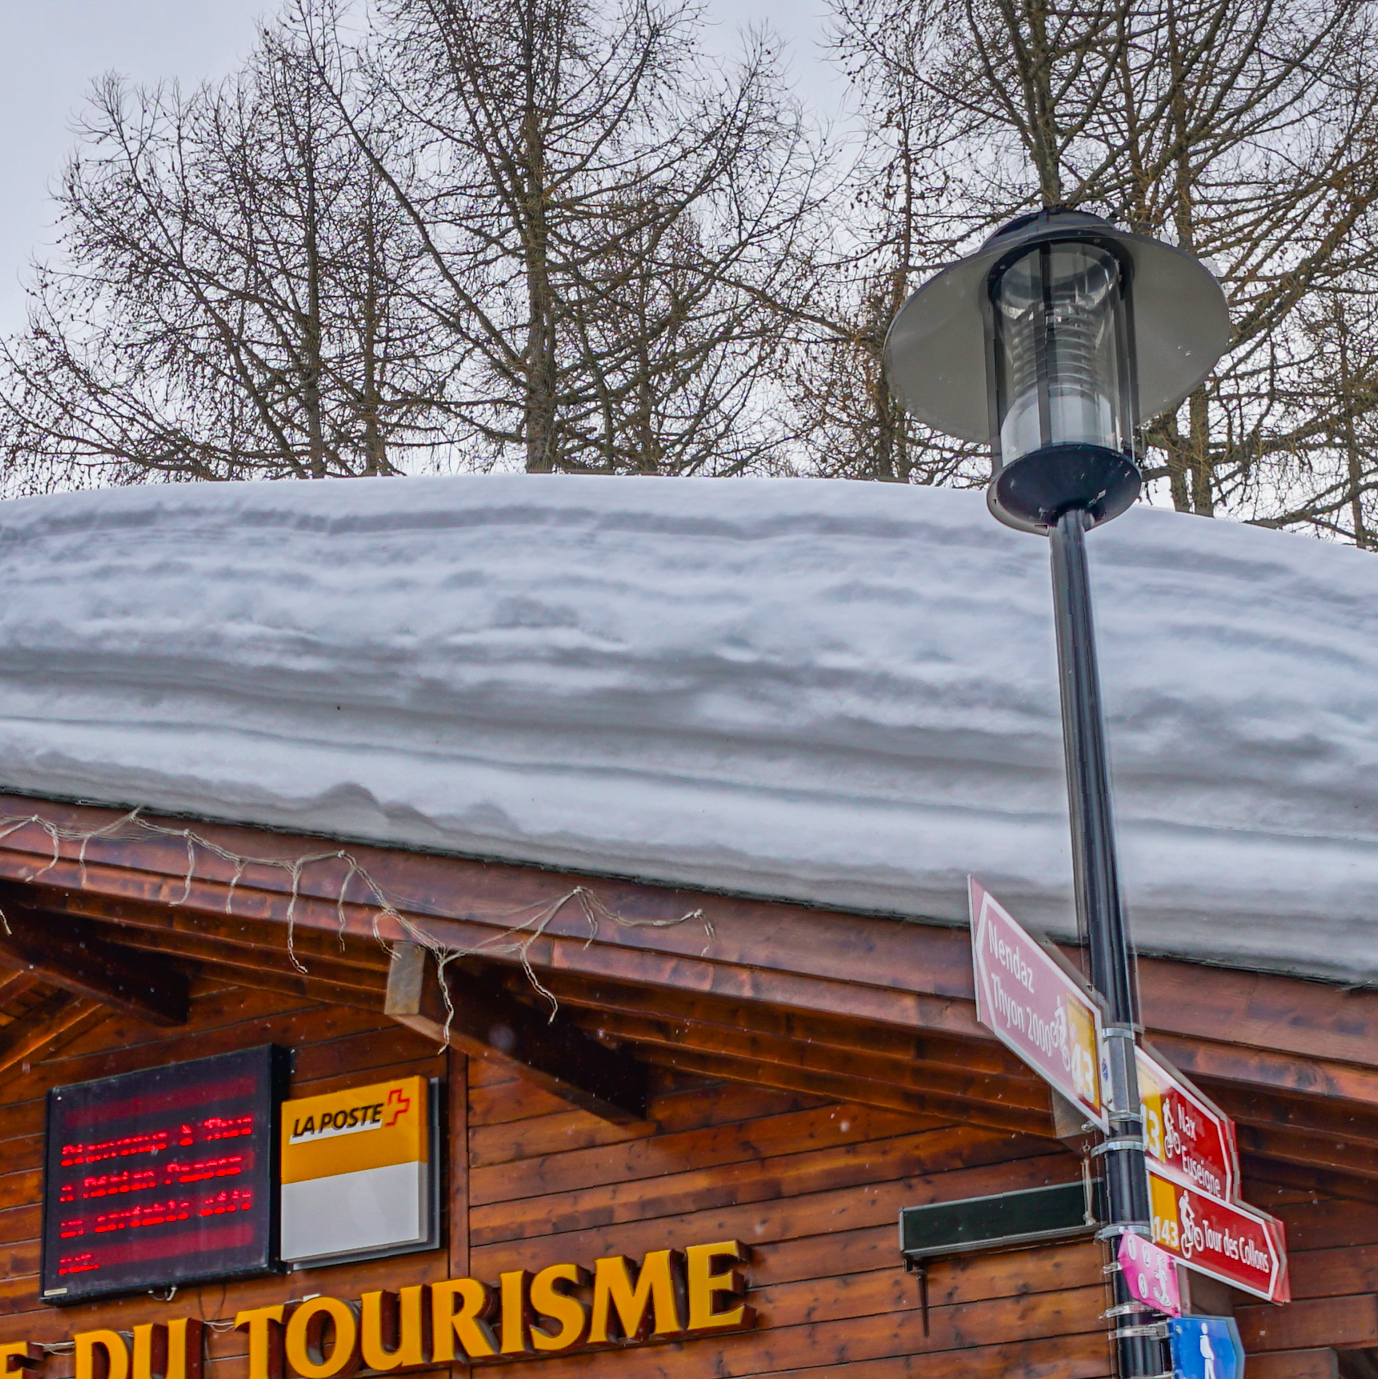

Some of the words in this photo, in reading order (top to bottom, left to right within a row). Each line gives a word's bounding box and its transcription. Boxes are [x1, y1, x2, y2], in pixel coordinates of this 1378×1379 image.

[987, 919, 1035, 994] Nendaz
[990, 972, 1025, 1034] Thyon
[1026, 1006, 1053, 1058] 2000
[1070, 1044, 1095, 1104] 43
[292, 1116, 317, 1138] LA
[319, 1104, 384, 1130] POSTE
[1177, 1102, 1197, 1142] Nax
[1180, 1145, 1222, 1198] Euseigne
[1152, 1215, 1179, 1248] 143
[1202, 1219, 1223, 1254] Tour
[1223, 1227, 1239, 1261] des
[1238, 1236, 1270, 1274] Collons
